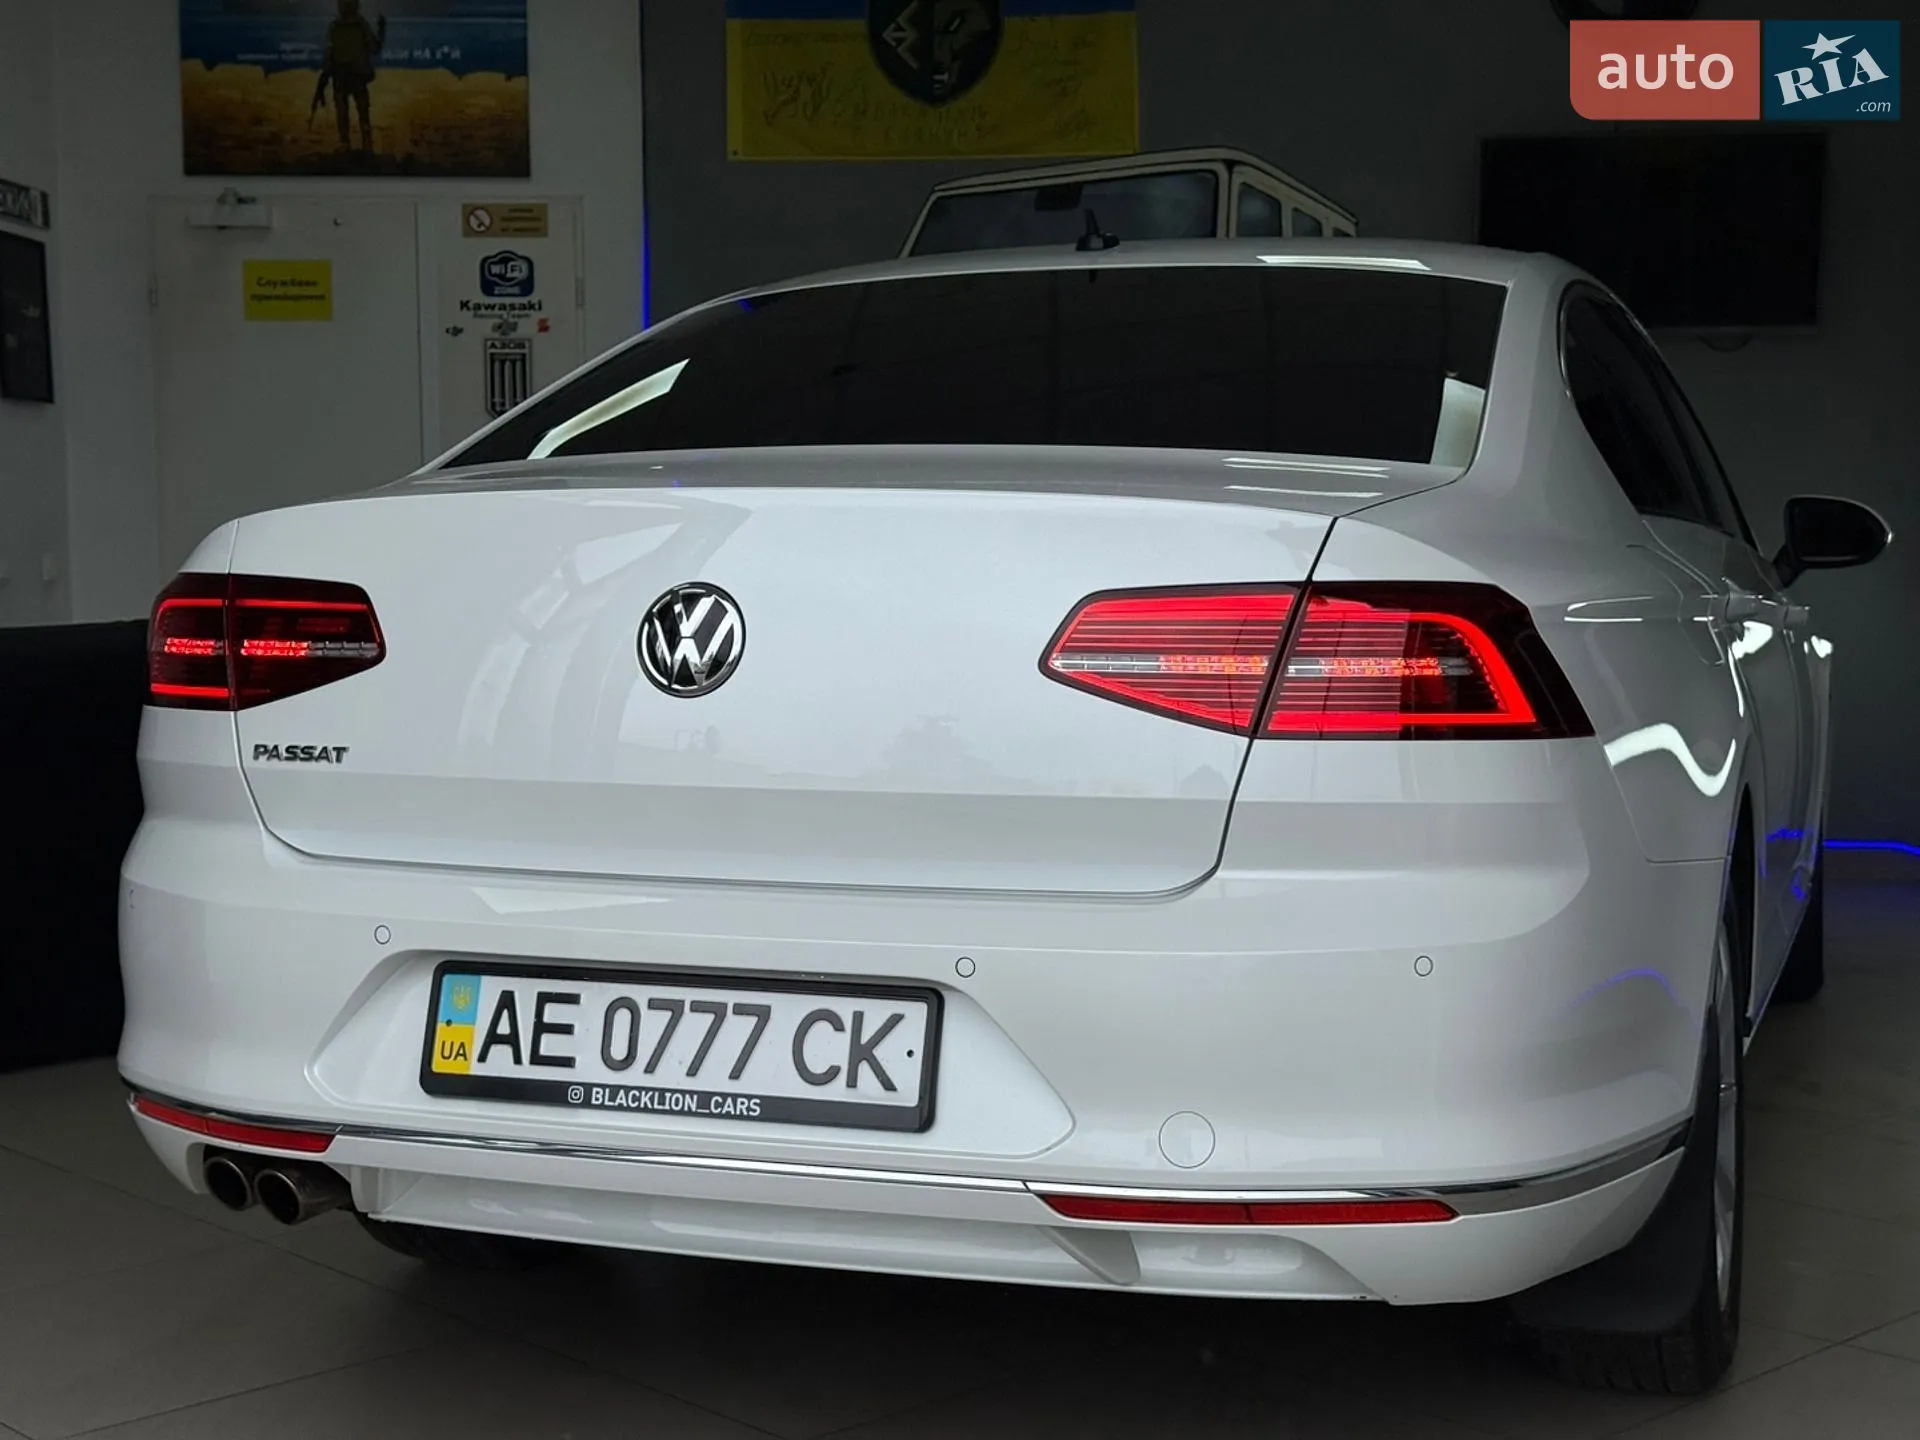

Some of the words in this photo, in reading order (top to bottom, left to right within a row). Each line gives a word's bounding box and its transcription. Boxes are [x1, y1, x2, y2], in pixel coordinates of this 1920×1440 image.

[460, 299, 543, 312] Kawasaki
[252, 743, 350, 764] PASSAT
[440, 1040, 469, 1062] UA
[477, 989, 582, 1069] AE
[601, 996, 772, 1081] 0777
[792, 1008, 906, 1093] CK
[590, 1086, 762, 1117] BLACKLION_CARS
